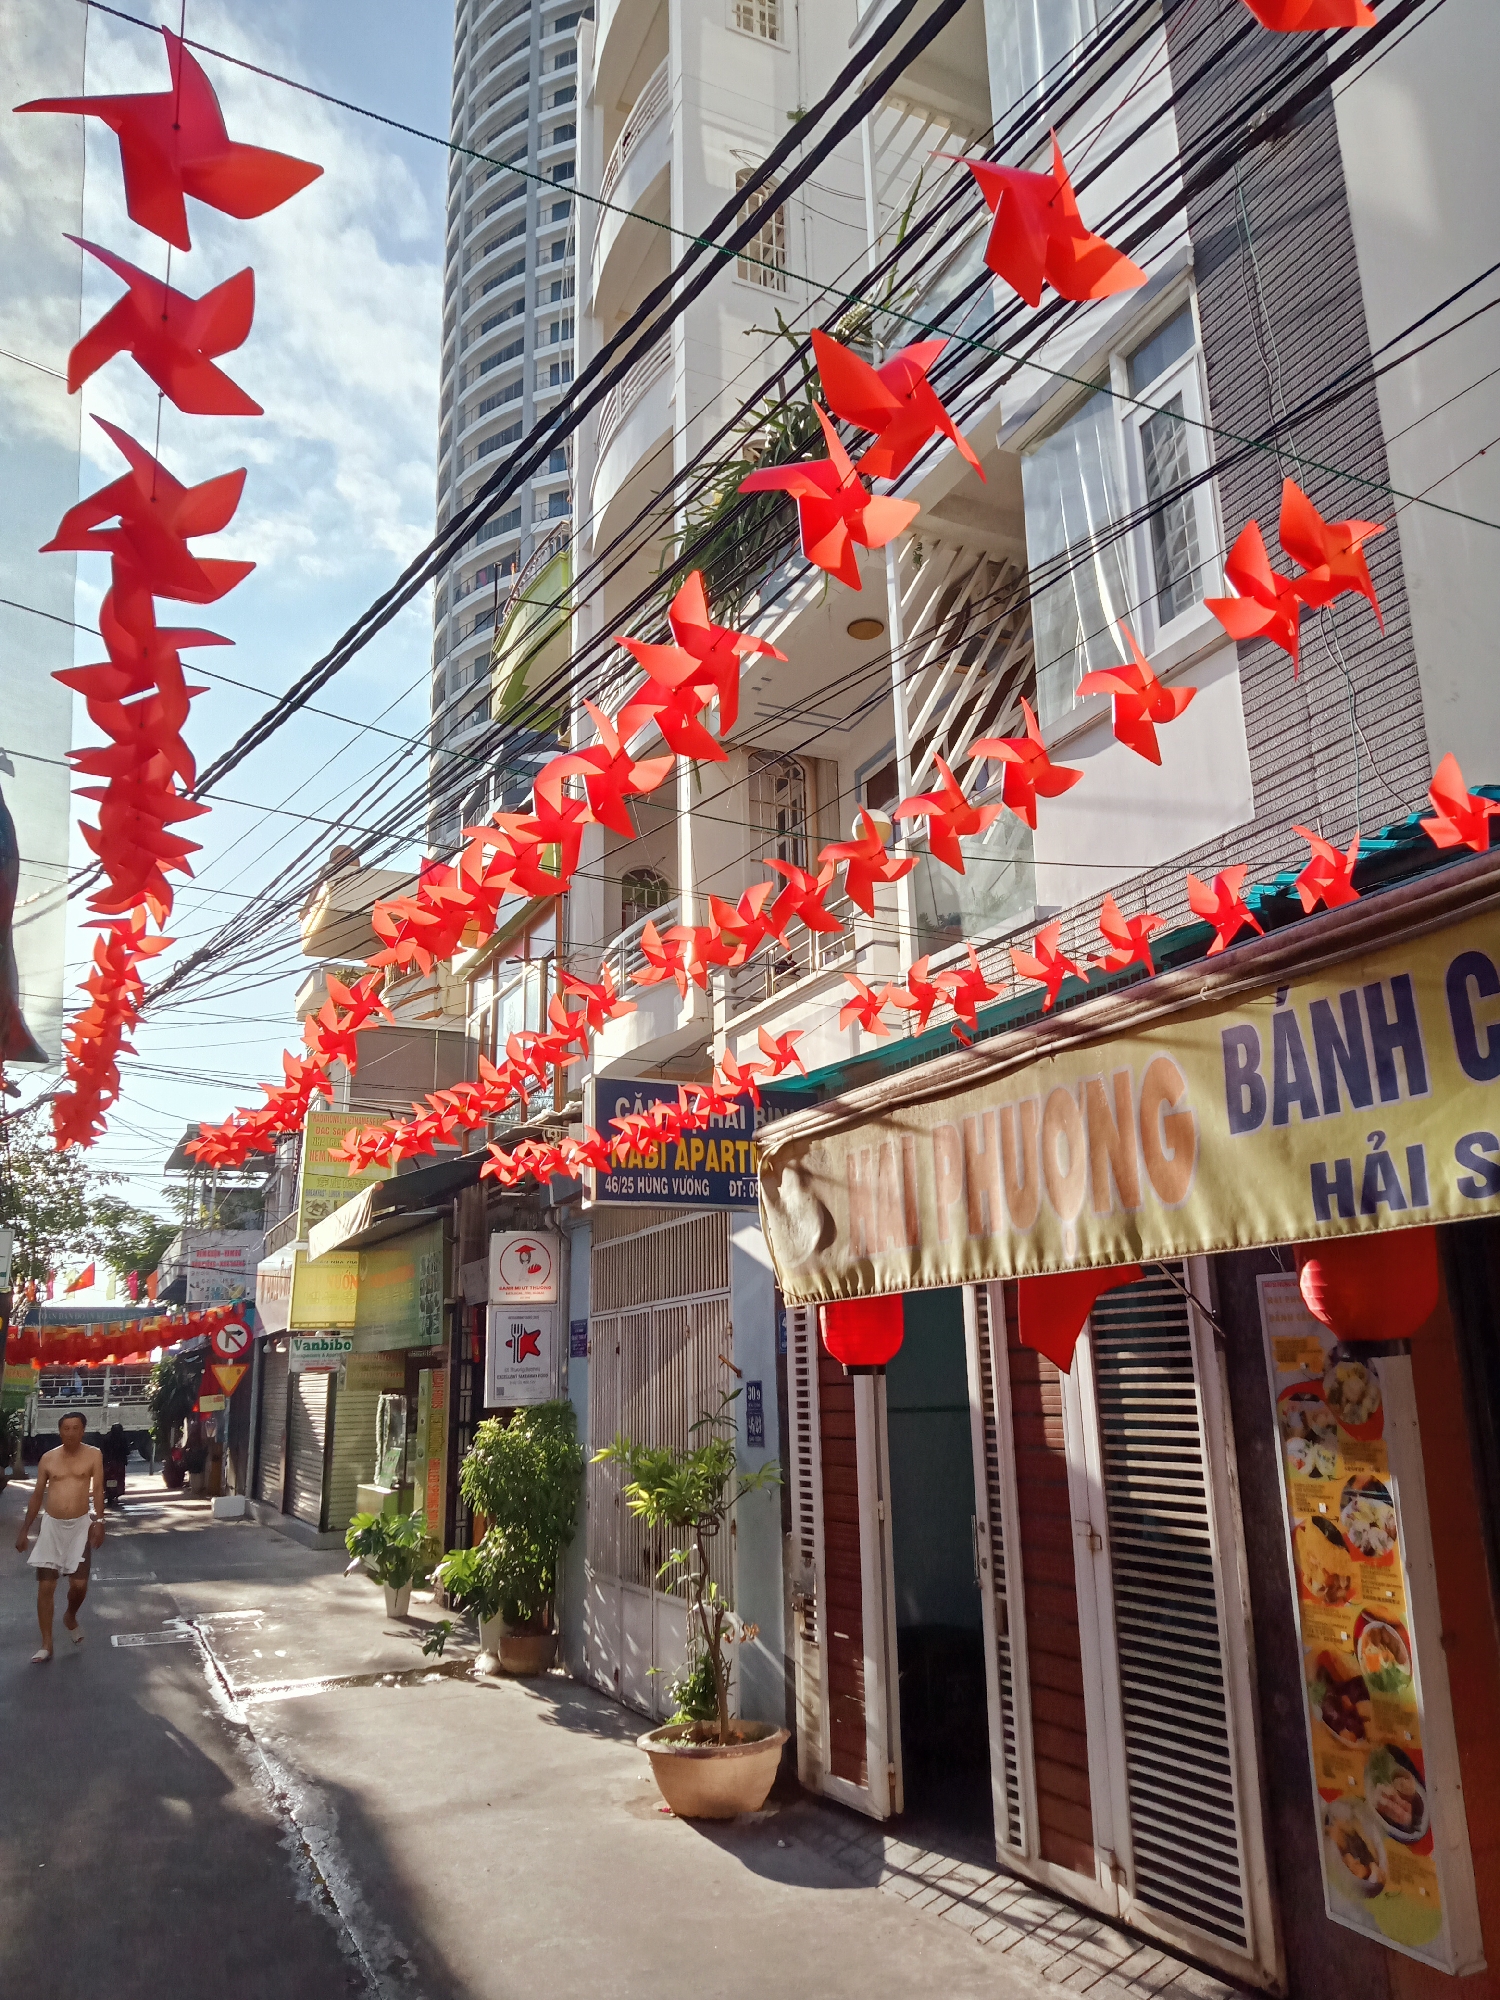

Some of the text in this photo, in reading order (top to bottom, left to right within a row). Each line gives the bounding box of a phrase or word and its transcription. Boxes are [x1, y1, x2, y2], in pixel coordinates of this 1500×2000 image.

[1221, 984, 1429, 1135] BÁNH
[604, 1175, 635, 1195] 46/25
[637, 1173, 669, 1195] HÙNG
[672, 1174, 710, 1197] VƯƠNG
[846, 1055, 1197, 1258] HAI PHƯỢNG
[1310, 1129, 1430, 1223] HẢI
[293, 1338, 352, 1351] Vanbibo
